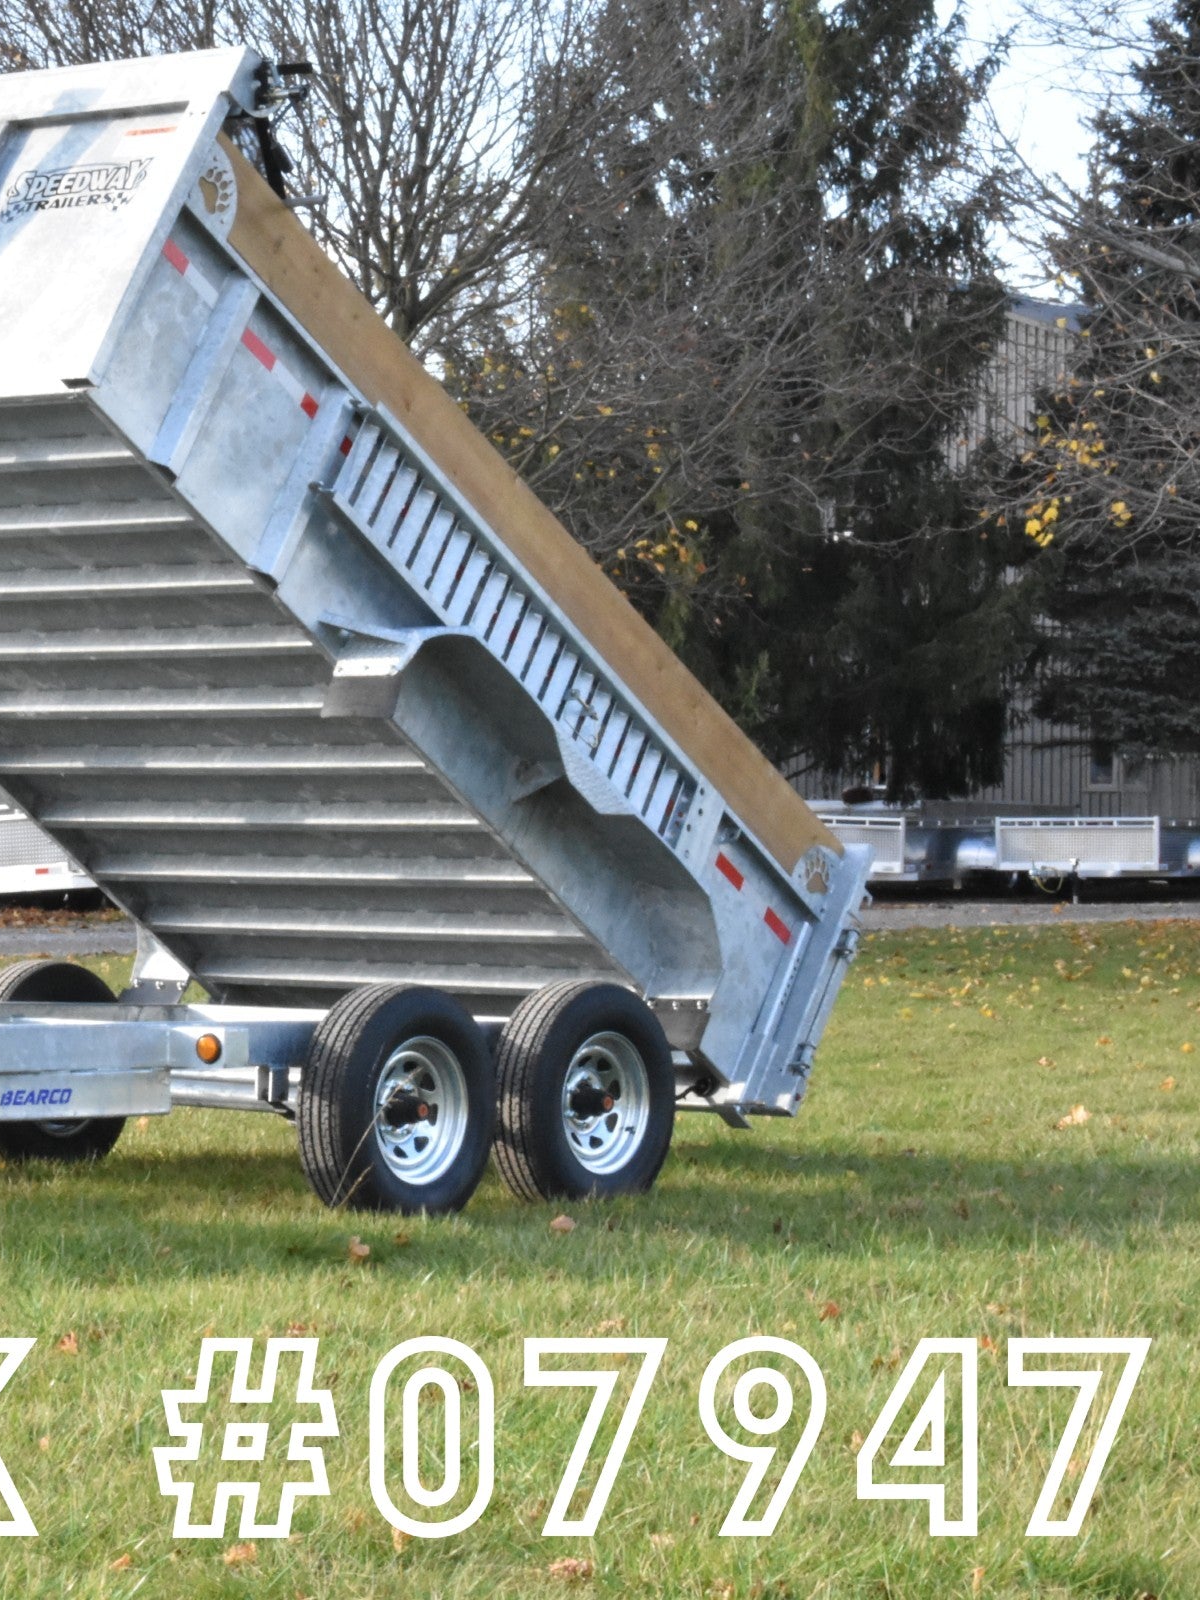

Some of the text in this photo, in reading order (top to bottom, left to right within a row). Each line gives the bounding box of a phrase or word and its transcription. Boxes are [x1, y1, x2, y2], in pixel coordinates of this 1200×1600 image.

[8, 157, 154, 204] SPEEDWAY
[24, 192, 113, 213] TRAILERS
[0, 1088, 73, 1107] BEARCO
